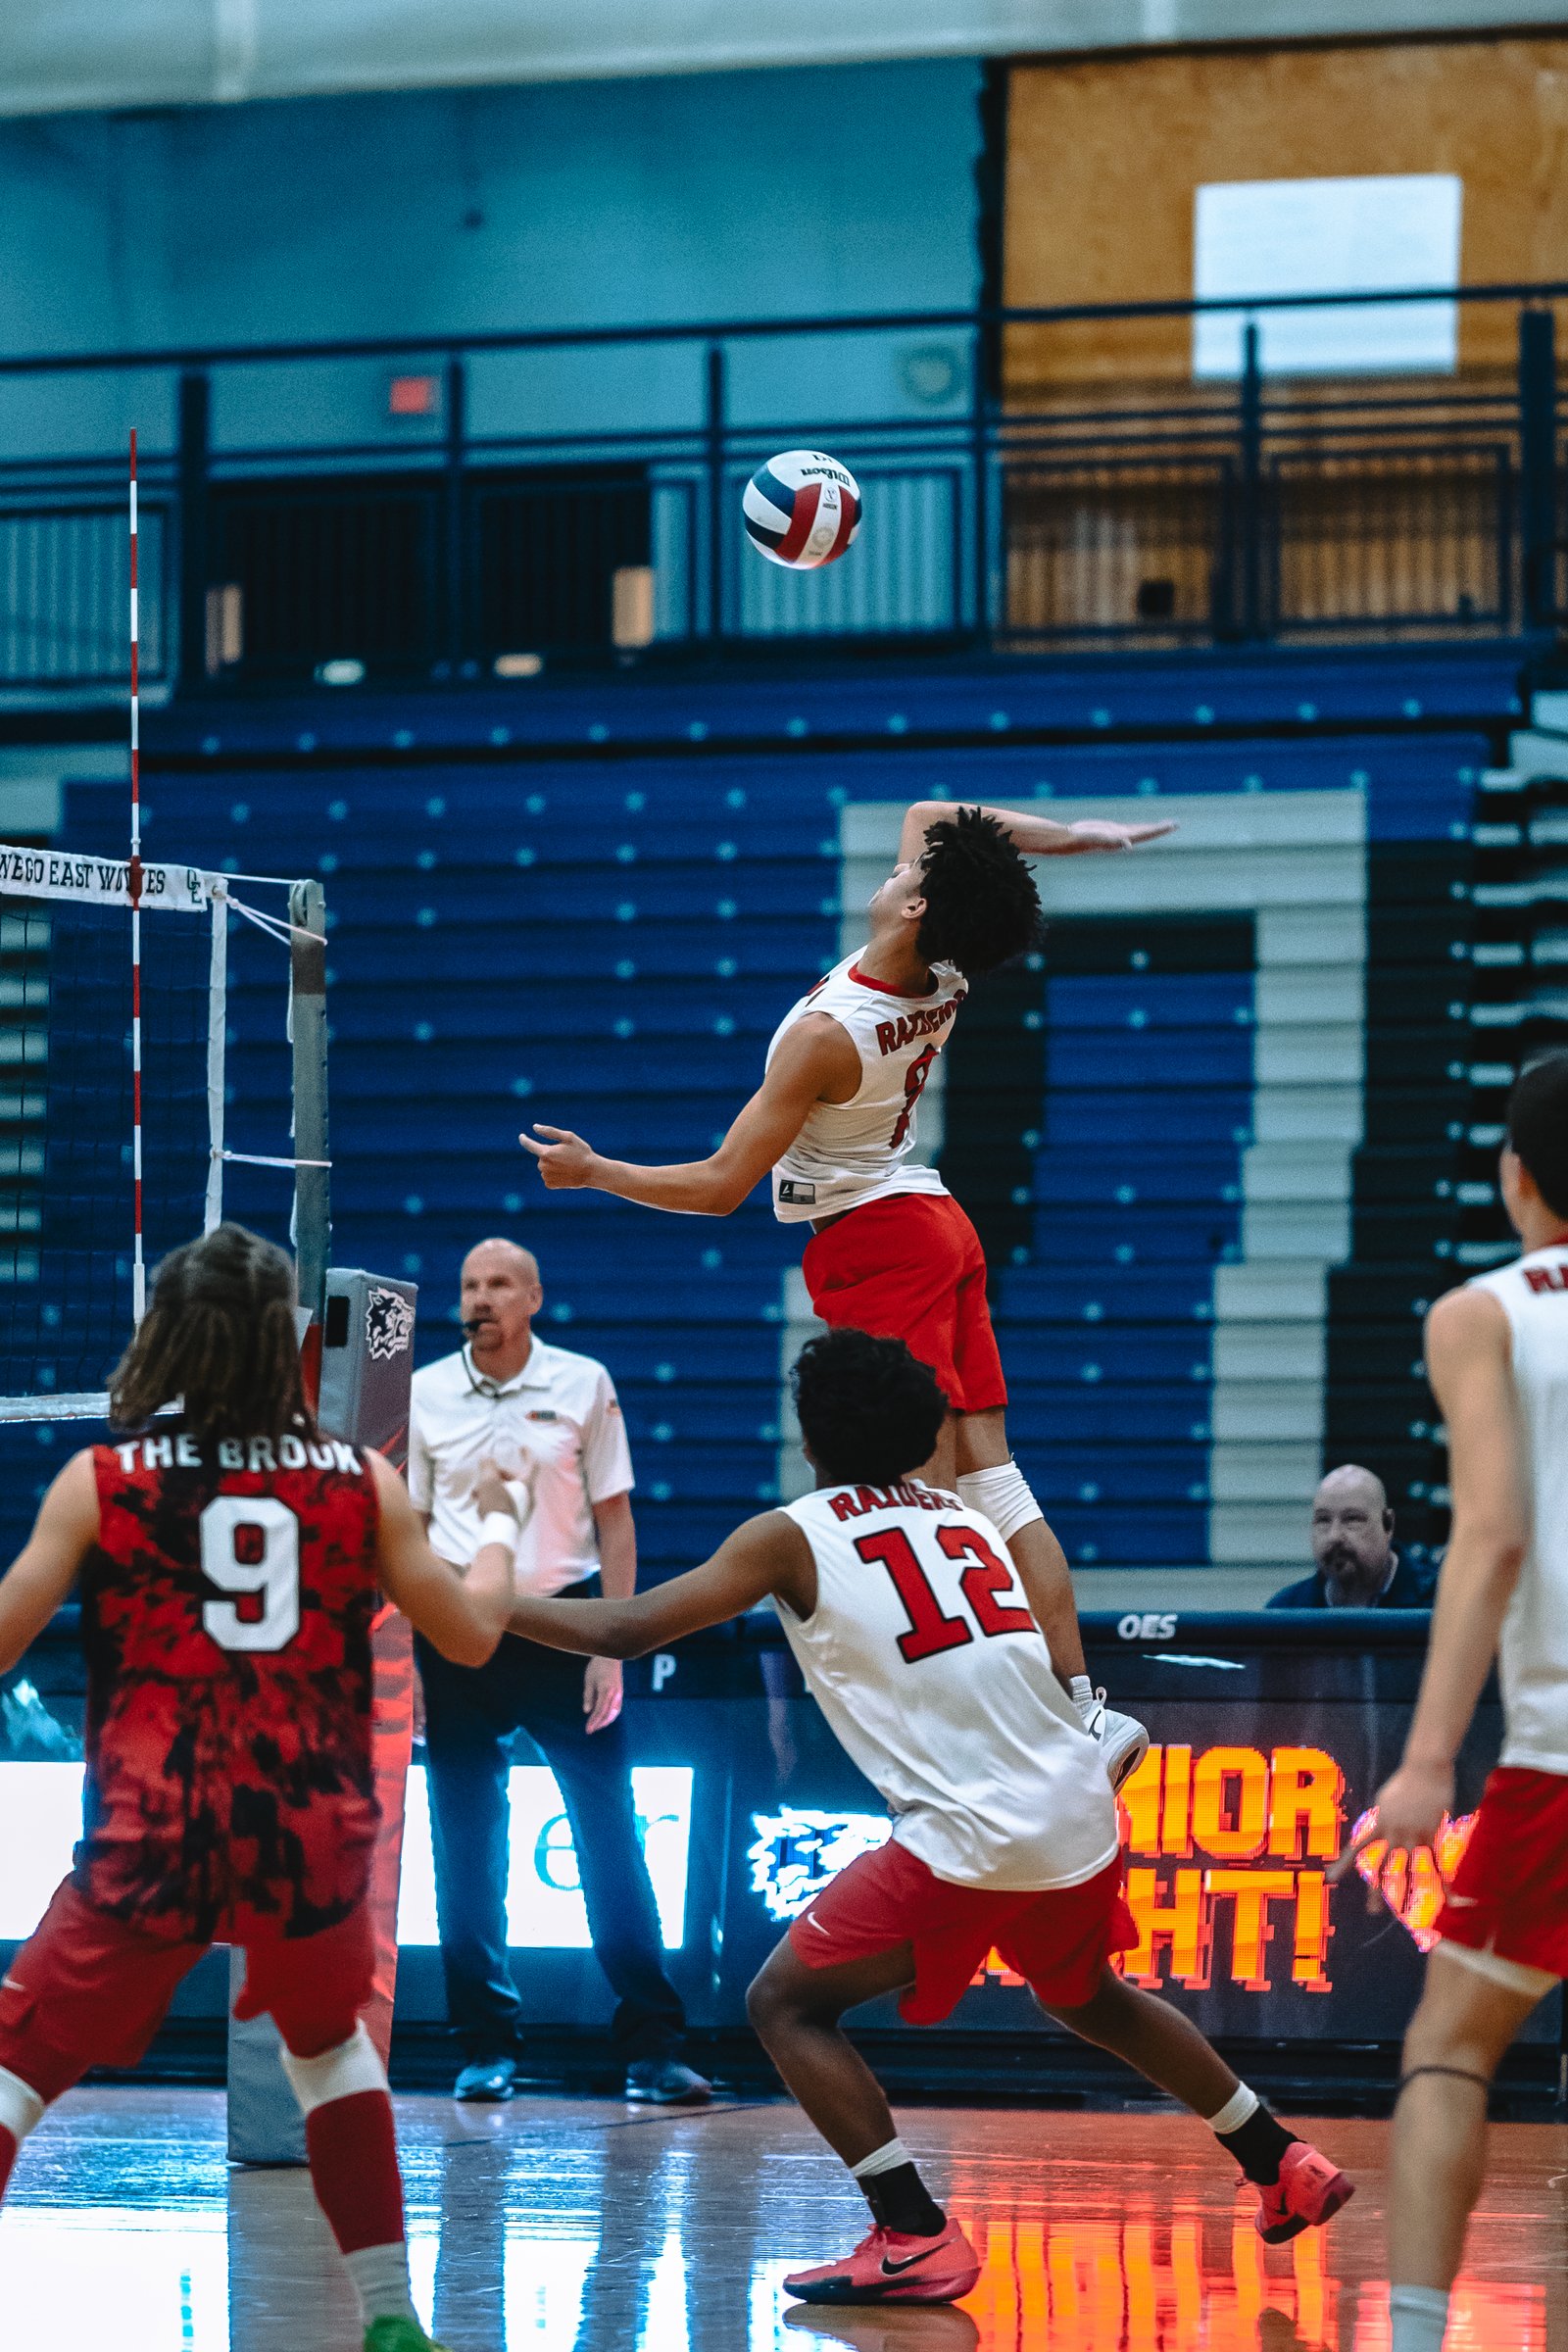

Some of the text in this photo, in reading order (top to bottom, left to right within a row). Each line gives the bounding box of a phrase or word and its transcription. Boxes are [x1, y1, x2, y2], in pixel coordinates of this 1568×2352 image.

[49, 860, 93, 888] EAST
[114, 1433, 203, 1474] THE
[199, 1495, 300, 1652] 9
[854, 1524, 1041, 1664] 12
[1117, 1614, 1179, 1641] OES
